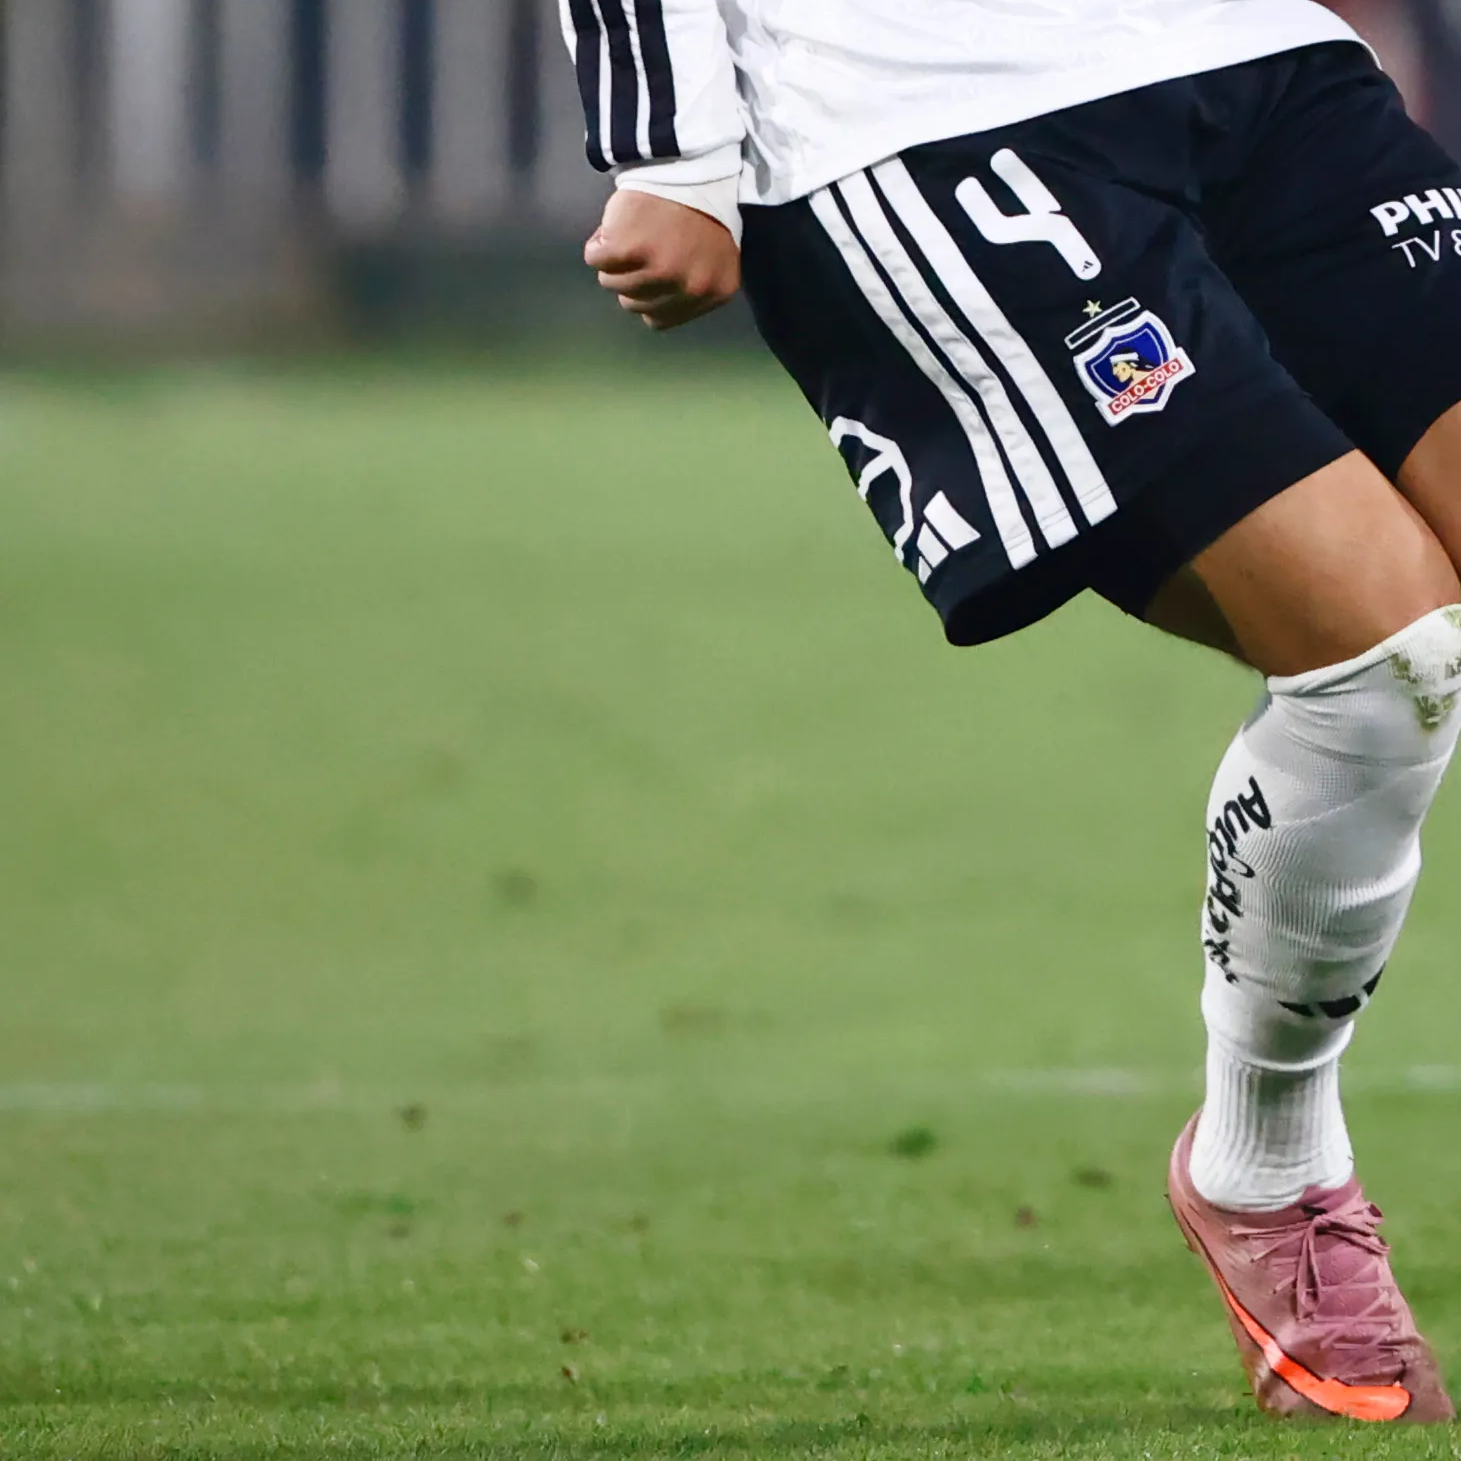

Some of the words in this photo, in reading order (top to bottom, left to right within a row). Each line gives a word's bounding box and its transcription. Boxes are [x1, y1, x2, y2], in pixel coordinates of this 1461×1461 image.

[955, 148, 1102, 281] 4
[1391, 229, 1440, 268] TV
[1111, 359, 1181, 413] COLO-COLO
